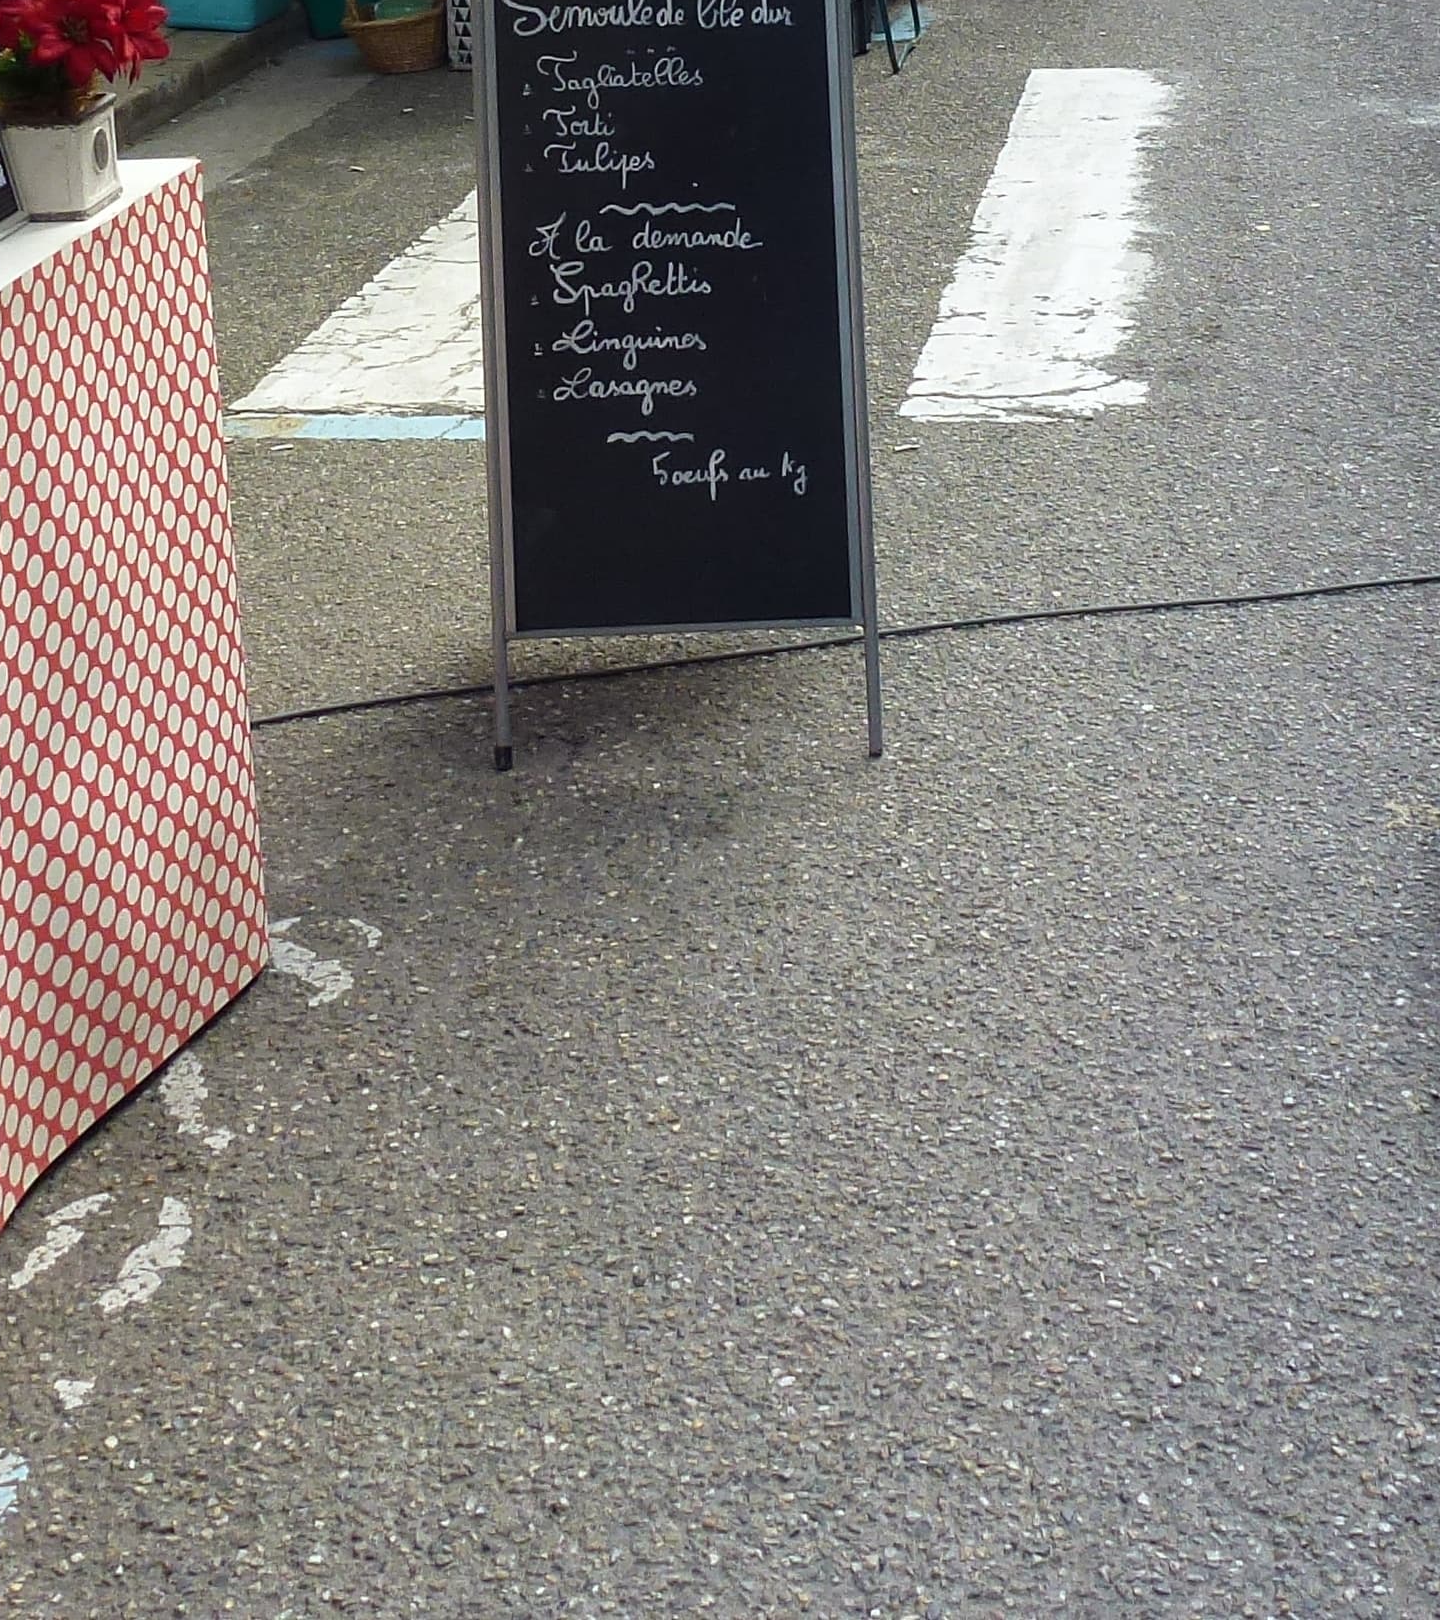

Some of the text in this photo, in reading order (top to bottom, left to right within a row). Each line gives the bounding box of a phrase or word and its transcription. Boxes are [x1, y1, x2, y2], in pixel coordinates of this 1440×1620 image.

[536, 49, 705, 110] Tagliatelles
[542, 105, 616, 137] Torti
[575, 219, 612, 253] la
[631, 217, 764, 250] demande
[549, 260, 712, 317] Spaghettis
[551, 319, 707, 371] Linguines
[552, 367, 698, 416] Lasagnes
[738, 465, 771, 480] au
